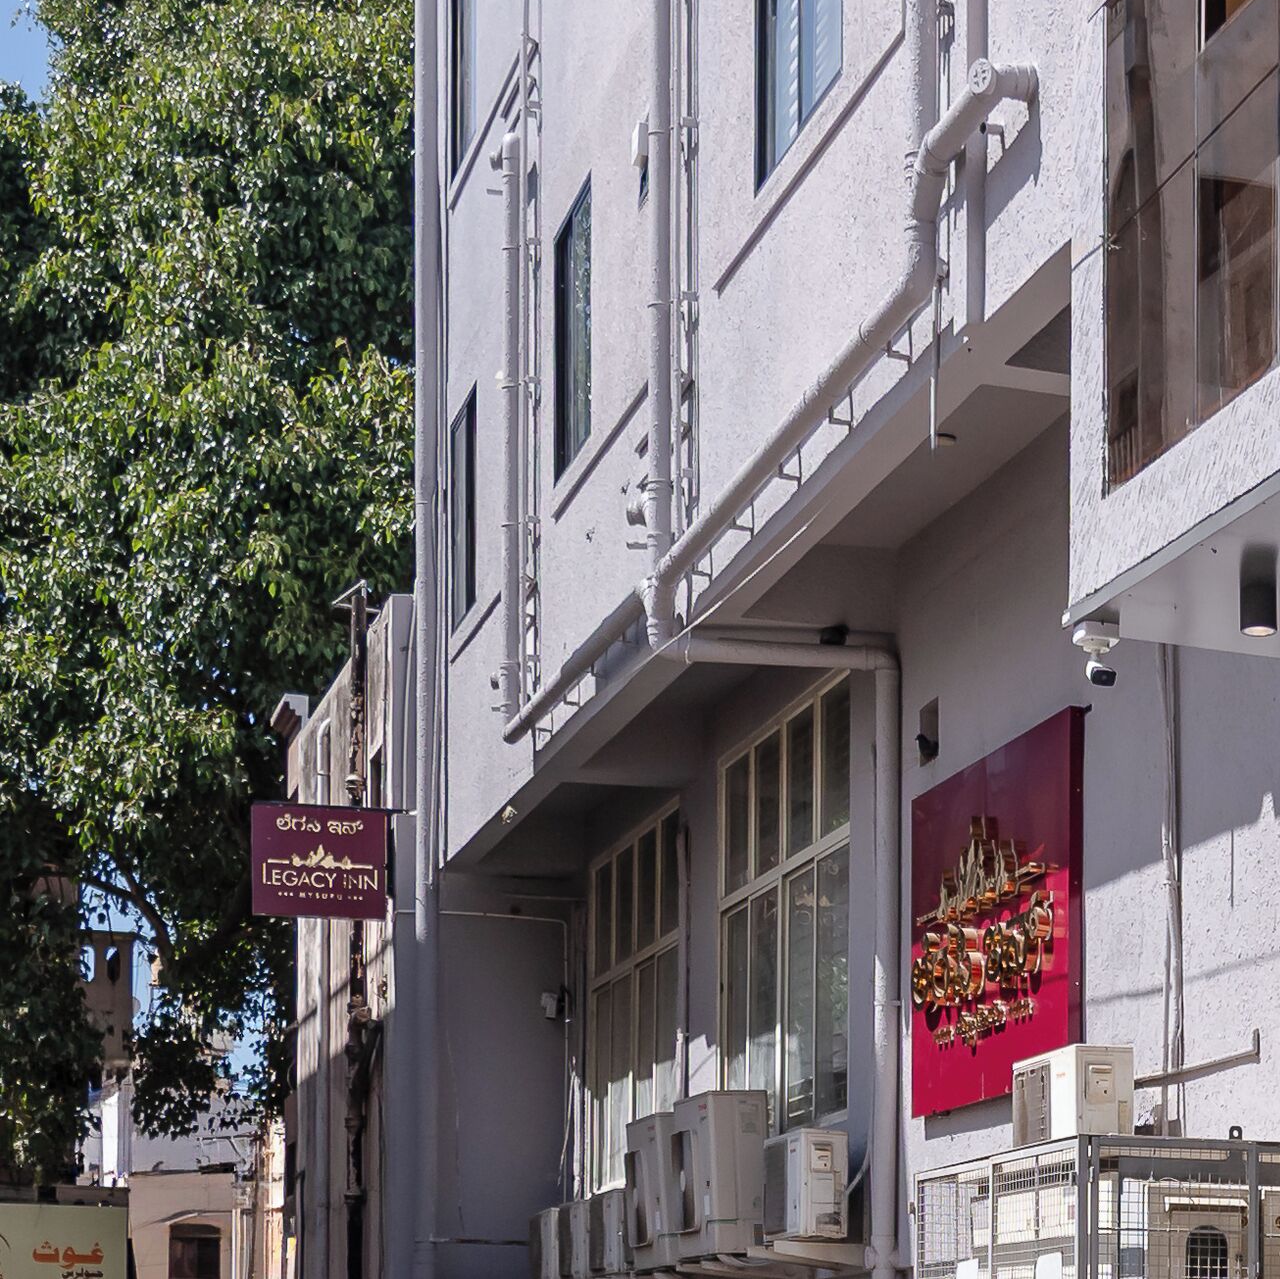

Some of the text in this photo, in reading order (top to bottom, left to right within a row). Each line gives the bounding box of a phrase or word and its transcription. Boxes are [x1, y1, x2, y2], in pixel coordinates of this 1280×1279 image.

[262, 862, 378, 890] LEGACY INN
[32, 1240, 104, 1270] غوث
